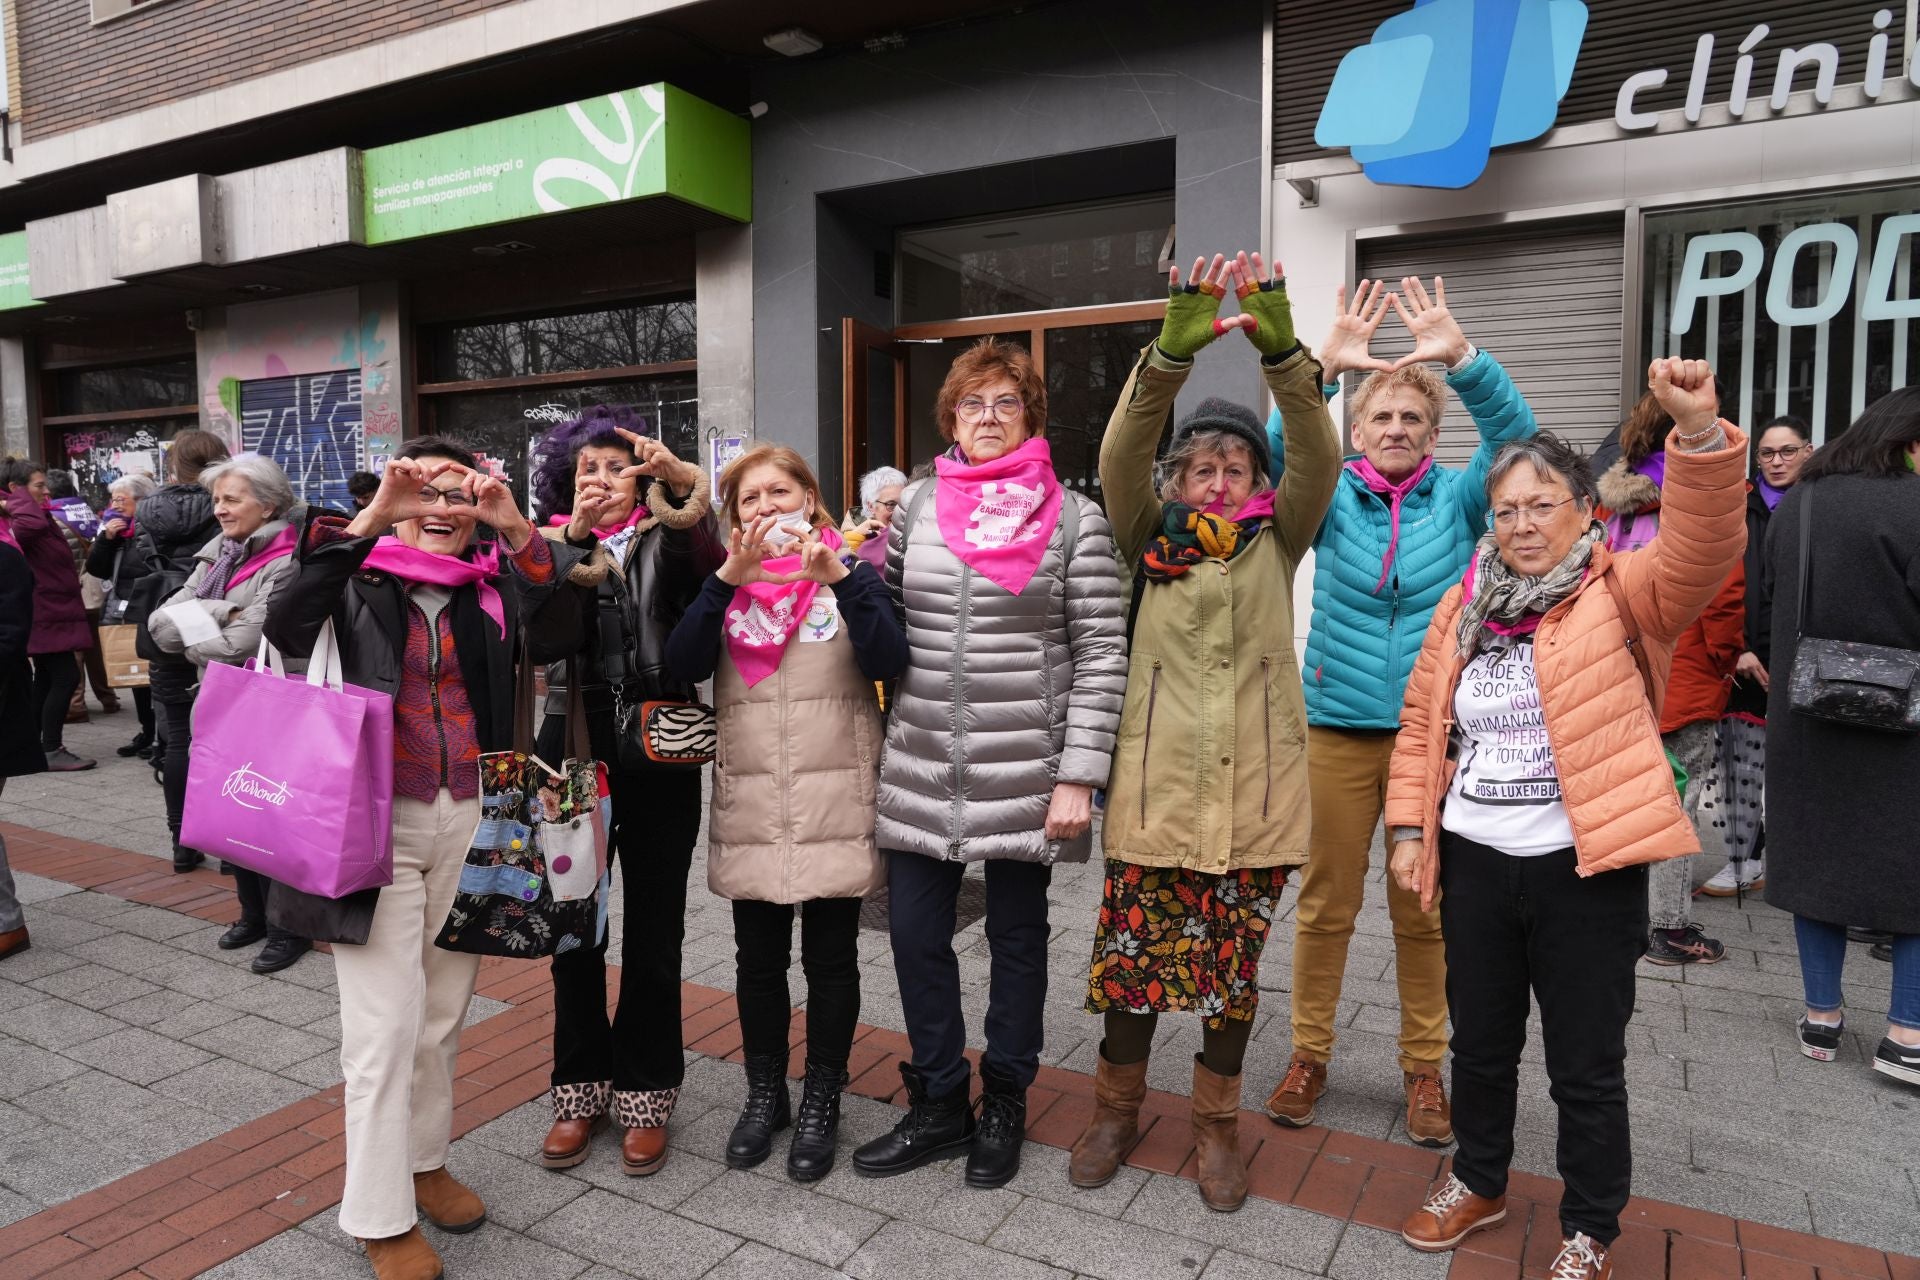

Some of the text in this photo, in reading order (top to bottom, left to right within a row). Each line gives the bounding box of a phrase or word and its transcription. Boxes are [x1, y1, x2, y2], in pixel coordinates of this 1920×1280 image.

[1615, 9, 1920, 130] clíni
[373, 158, 524, 199] Servicio de atención integral a
[373, 182, 494, 215] familias monoparentales
[1467, 664, 1516, 680] DONDE
[1485, 747, 1494, 760] Y
[1475, 784, 1499, 798] ROSA
